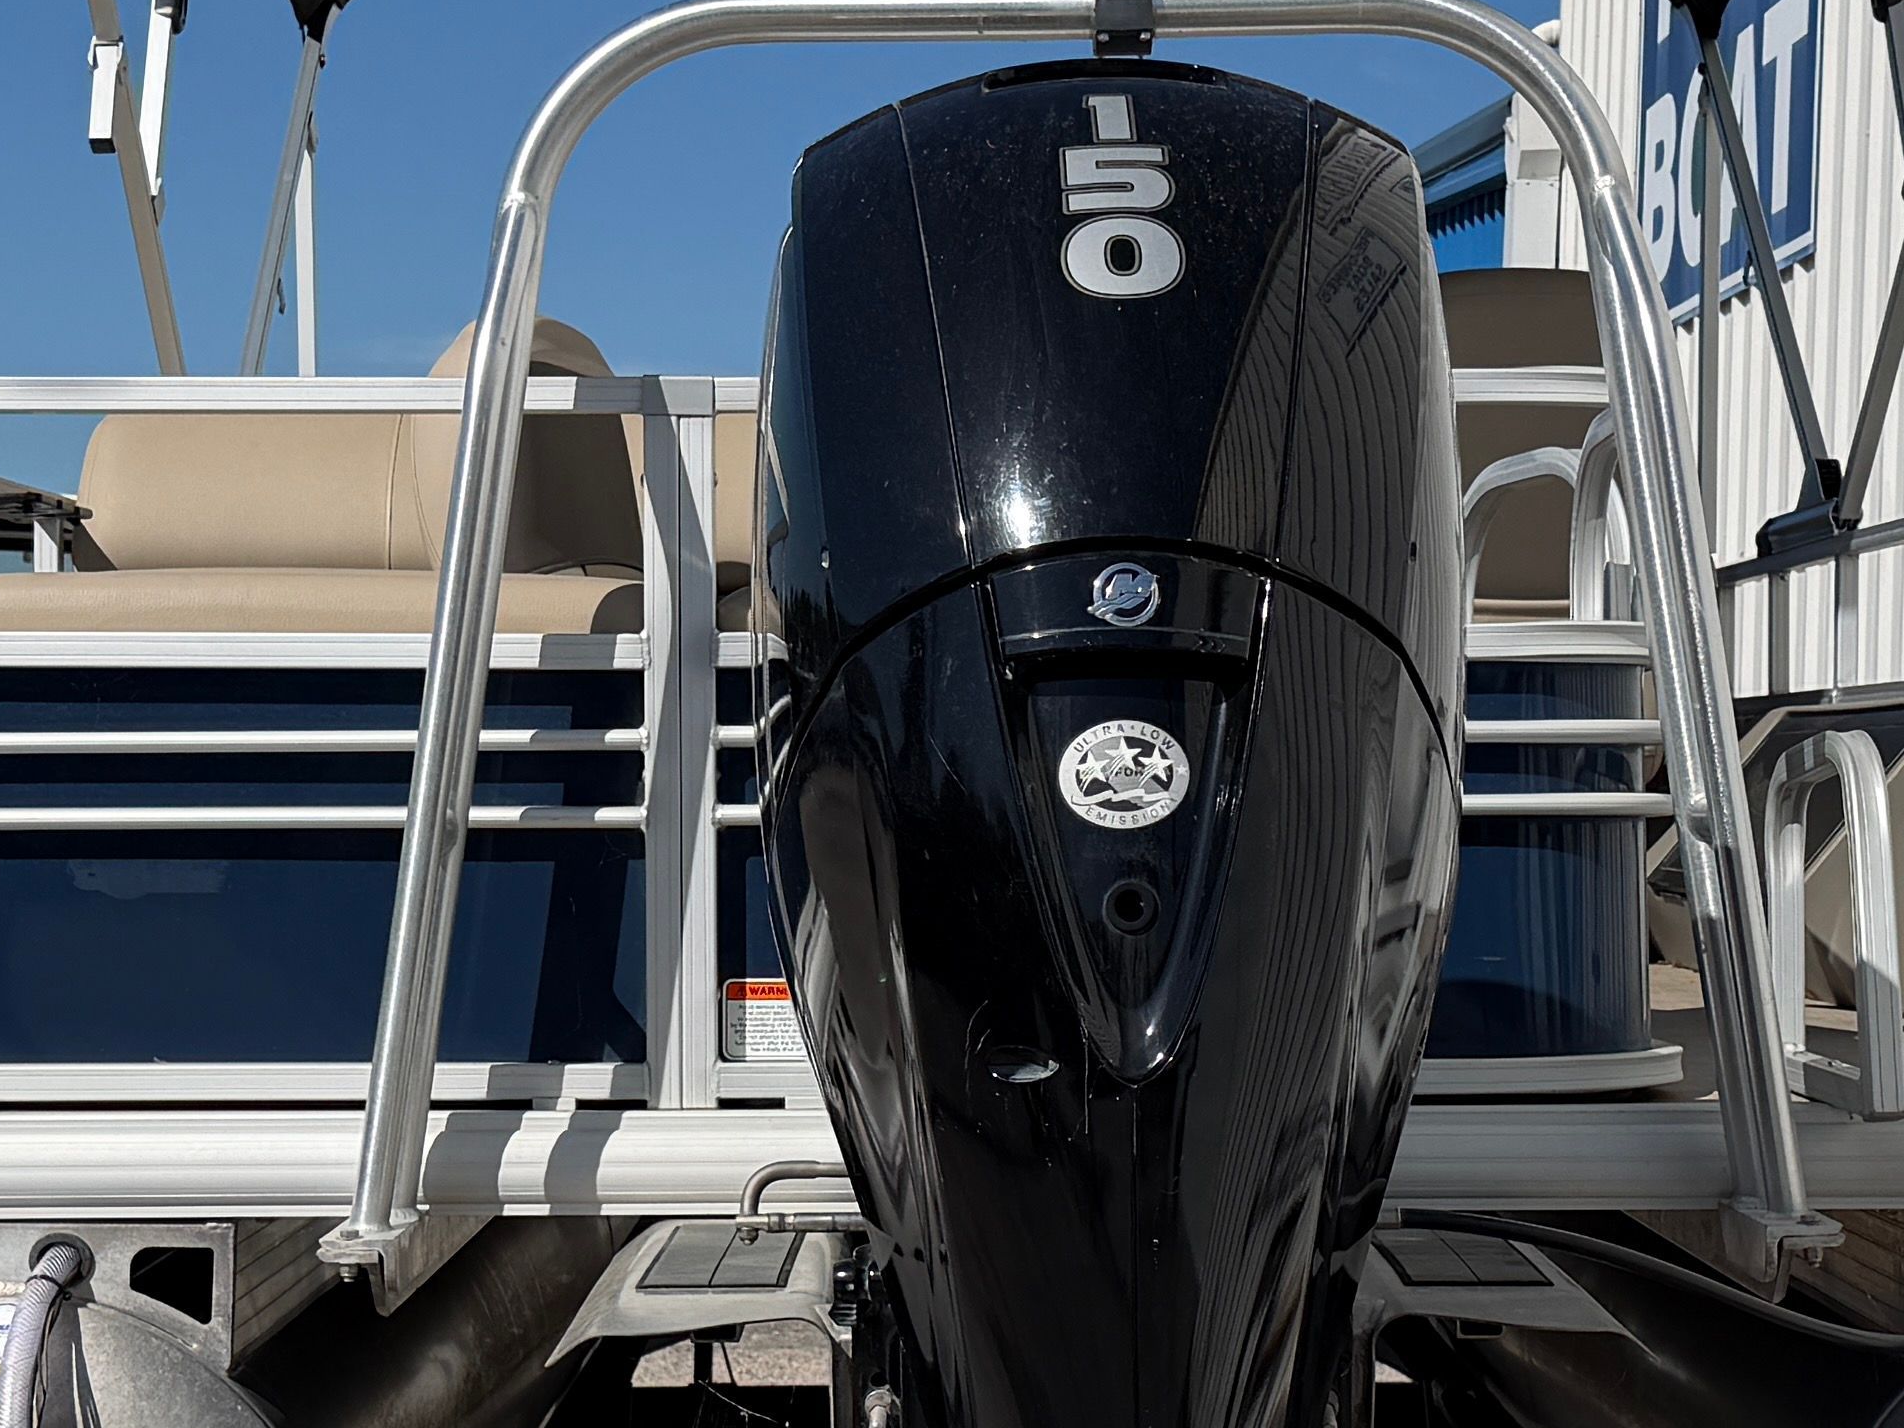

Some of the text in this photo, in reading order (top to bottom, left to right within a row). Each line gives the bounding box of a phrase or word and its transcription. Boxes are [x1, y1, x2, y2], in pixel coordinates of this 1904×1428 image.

[1059, 93, 1186, 299] 150
[1073, 723, 1176, 753] ULTRA LOW
[1085, 800, 1171, 826] EMISSION
